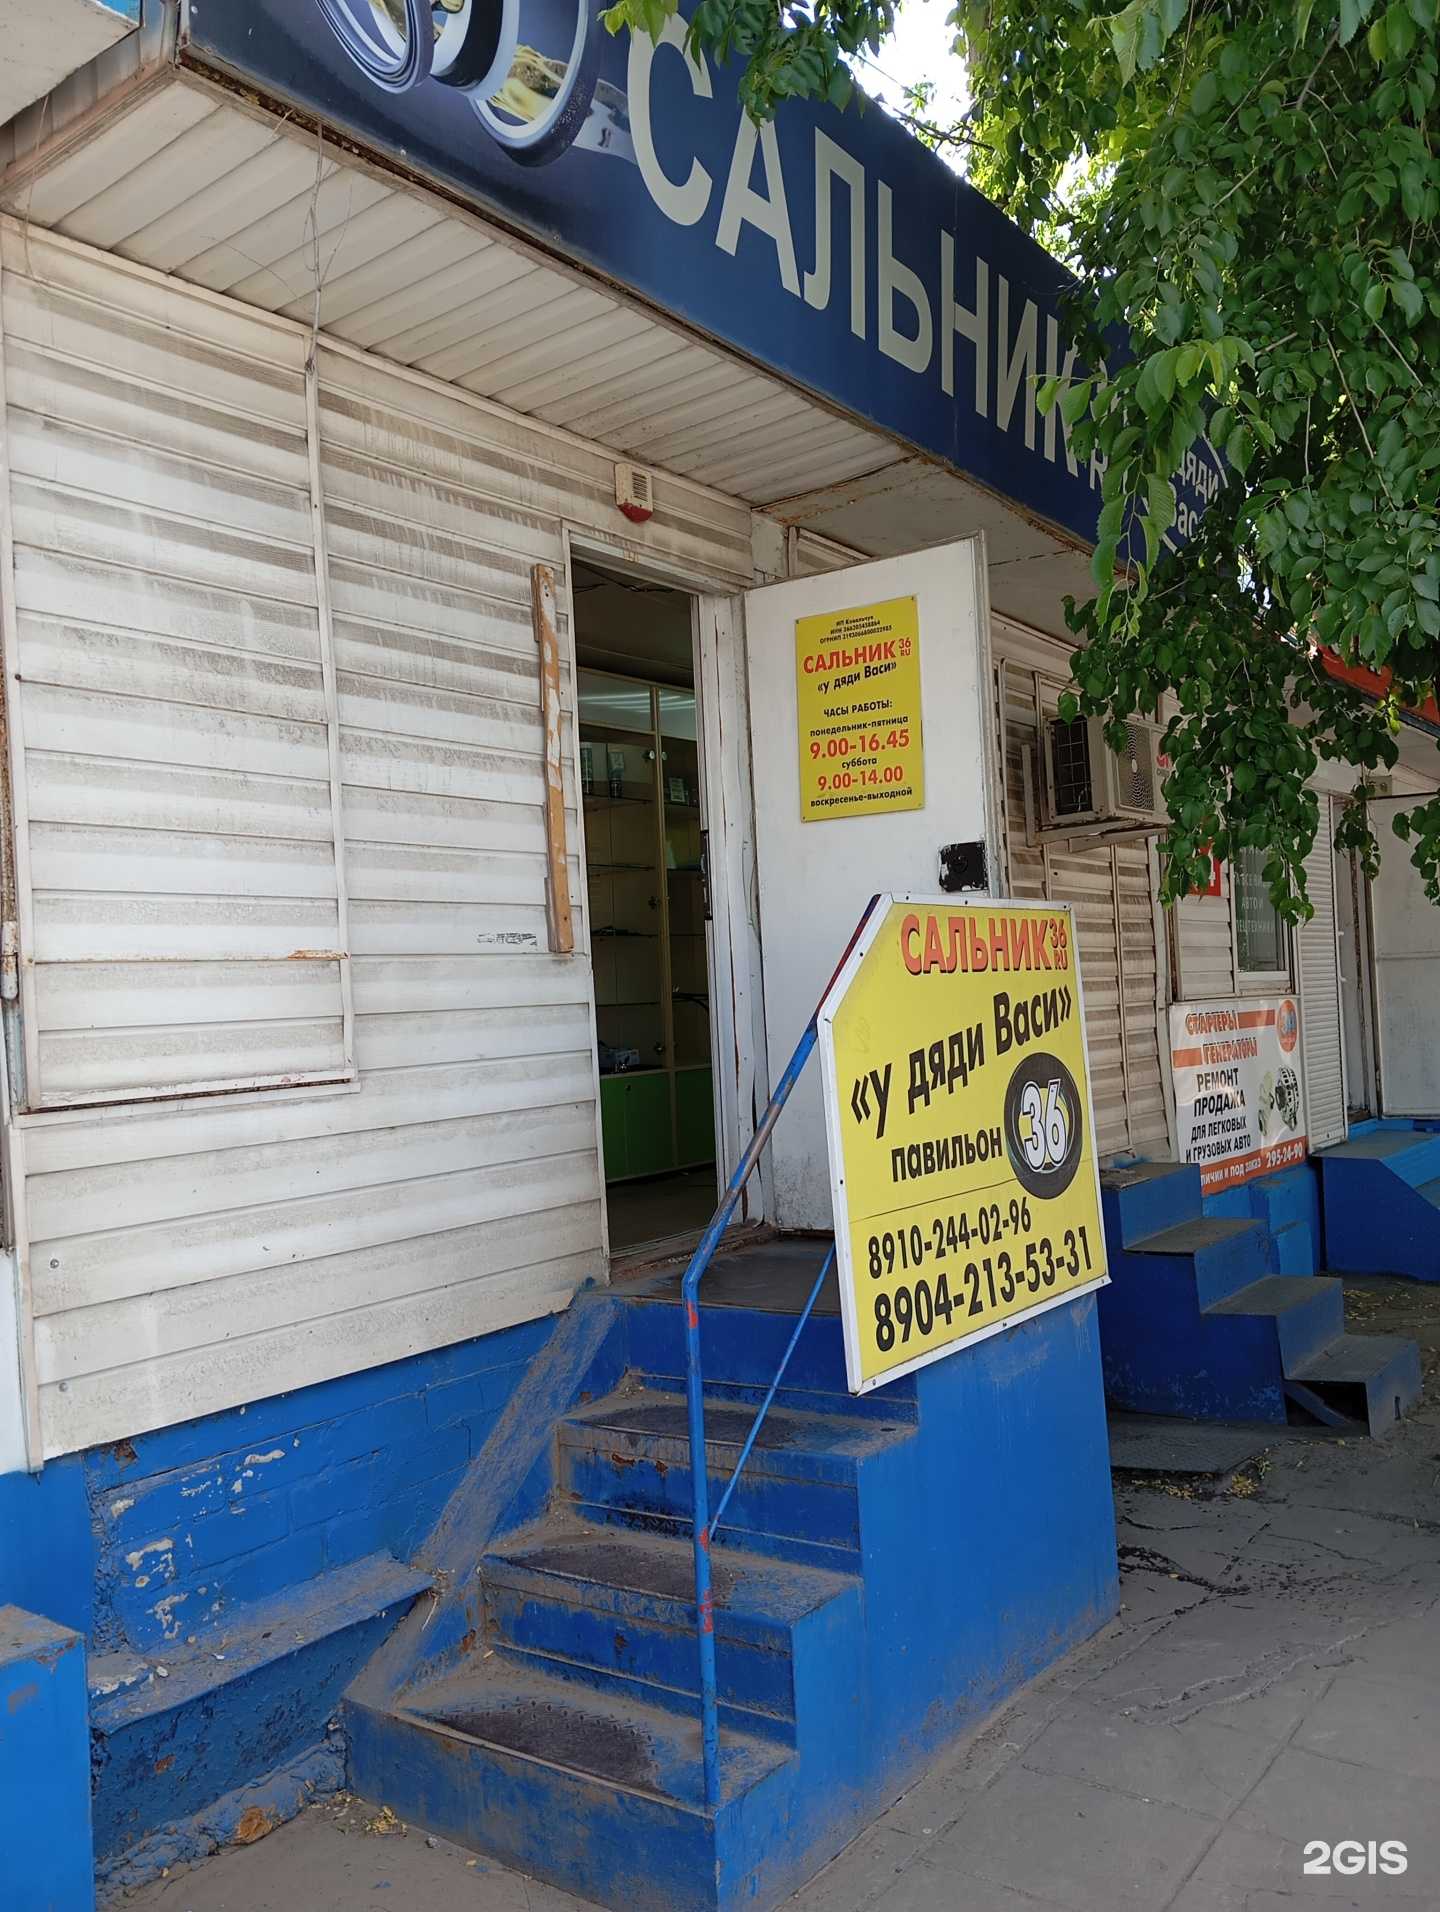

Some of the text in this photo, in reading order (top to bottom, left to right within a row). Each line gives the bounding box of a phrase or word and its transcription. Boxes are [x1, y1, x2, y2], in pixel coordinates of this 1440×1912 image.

[627, 12, 1079, 478] САЛЬНИК
[803, 639, 897, 674] САЛЬНИК
[898, 637, 911, 649] 36
[833, 672, 861, 690] дяди
[864, 661, 897, 679] Васи»
[823, 699, 893, 718] ЧАСЫ РАБОТЫ:
[809, 715, 909, 737] понедельник-пятница
[809, 729, 910, 760] 9.00-16.45
[841, 756, 878, 769] суббота
[817, 765, 904, 791] 9.00-14.00
[810, 787, 913, 808] воскресенье-выходной
[900, 913, 1051, 976] САЛЬНИК
[1049, 918, 1068, 949] 36
[1054, 948, 1068, 970] RU
[1185, 1010, 1239, 1035] СТАРТЕРЫ
[907, 1022, 985, 1115] дяди
[993, 984, 1072, 1056] Васи»
[1202, 1037, 1258, 1064] ГЕНЕРАТОРЫ
[1196, 1068, 1238, 1092] РЕМОНТ
[1194, 1089, 1246, 1117] ПРОДАЖА
[1021, 1078, 1069, 1173] 36
[1191, 1116, 1247, 1144] ДЛЯ ЛЕГКОВЫХ
[891, 1125, 1003, 1183] павильон
[1193, 1138, 1232, 1161] ГРУЗОВЫХ
[1234, 1134, 1251, 1151] АВТО
[868, 1197, 1032, 1280] 8910-244-02-96
[874, 1225, 1093, 1353] 8904-213-53-31
